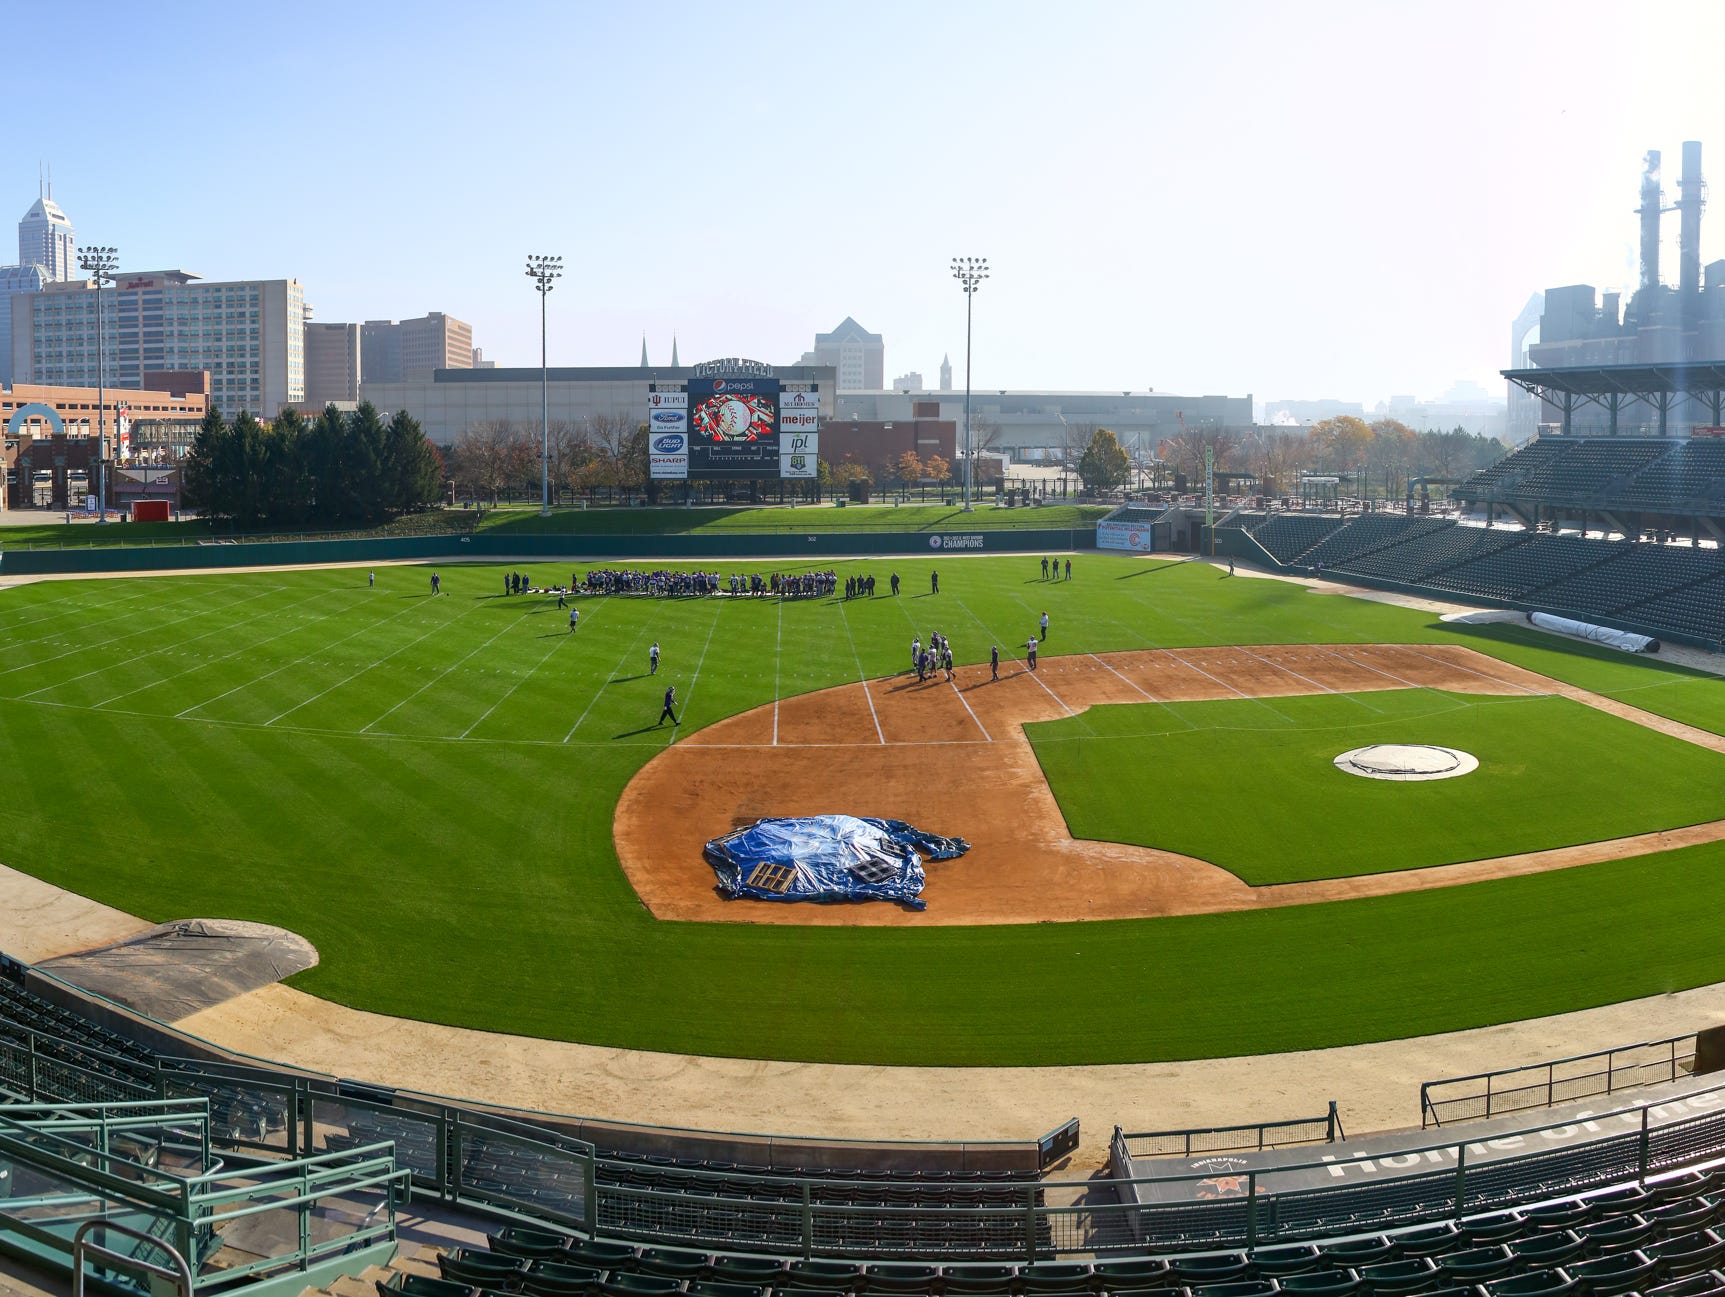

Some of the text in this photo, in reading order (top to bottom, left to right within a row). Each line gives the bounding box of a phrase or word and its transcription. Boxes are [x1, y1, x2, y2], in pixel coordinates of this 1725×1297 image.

[694, 357, 774, 378] VICTORY FIELD
[727, 382, 754, 391] pepsi
[658, 413, 679, 421] Ford
[781, 413, 817, 426] meijer
[791, 434, 809, 453] ipl
[791, 456, 805, 465] 811
[943, 540, 984, 549] CHAMPIONS
[1321, 1134, 1526, 1177] Home
[1190, 1157, 1248, 1168] INDIANAPOLIS
